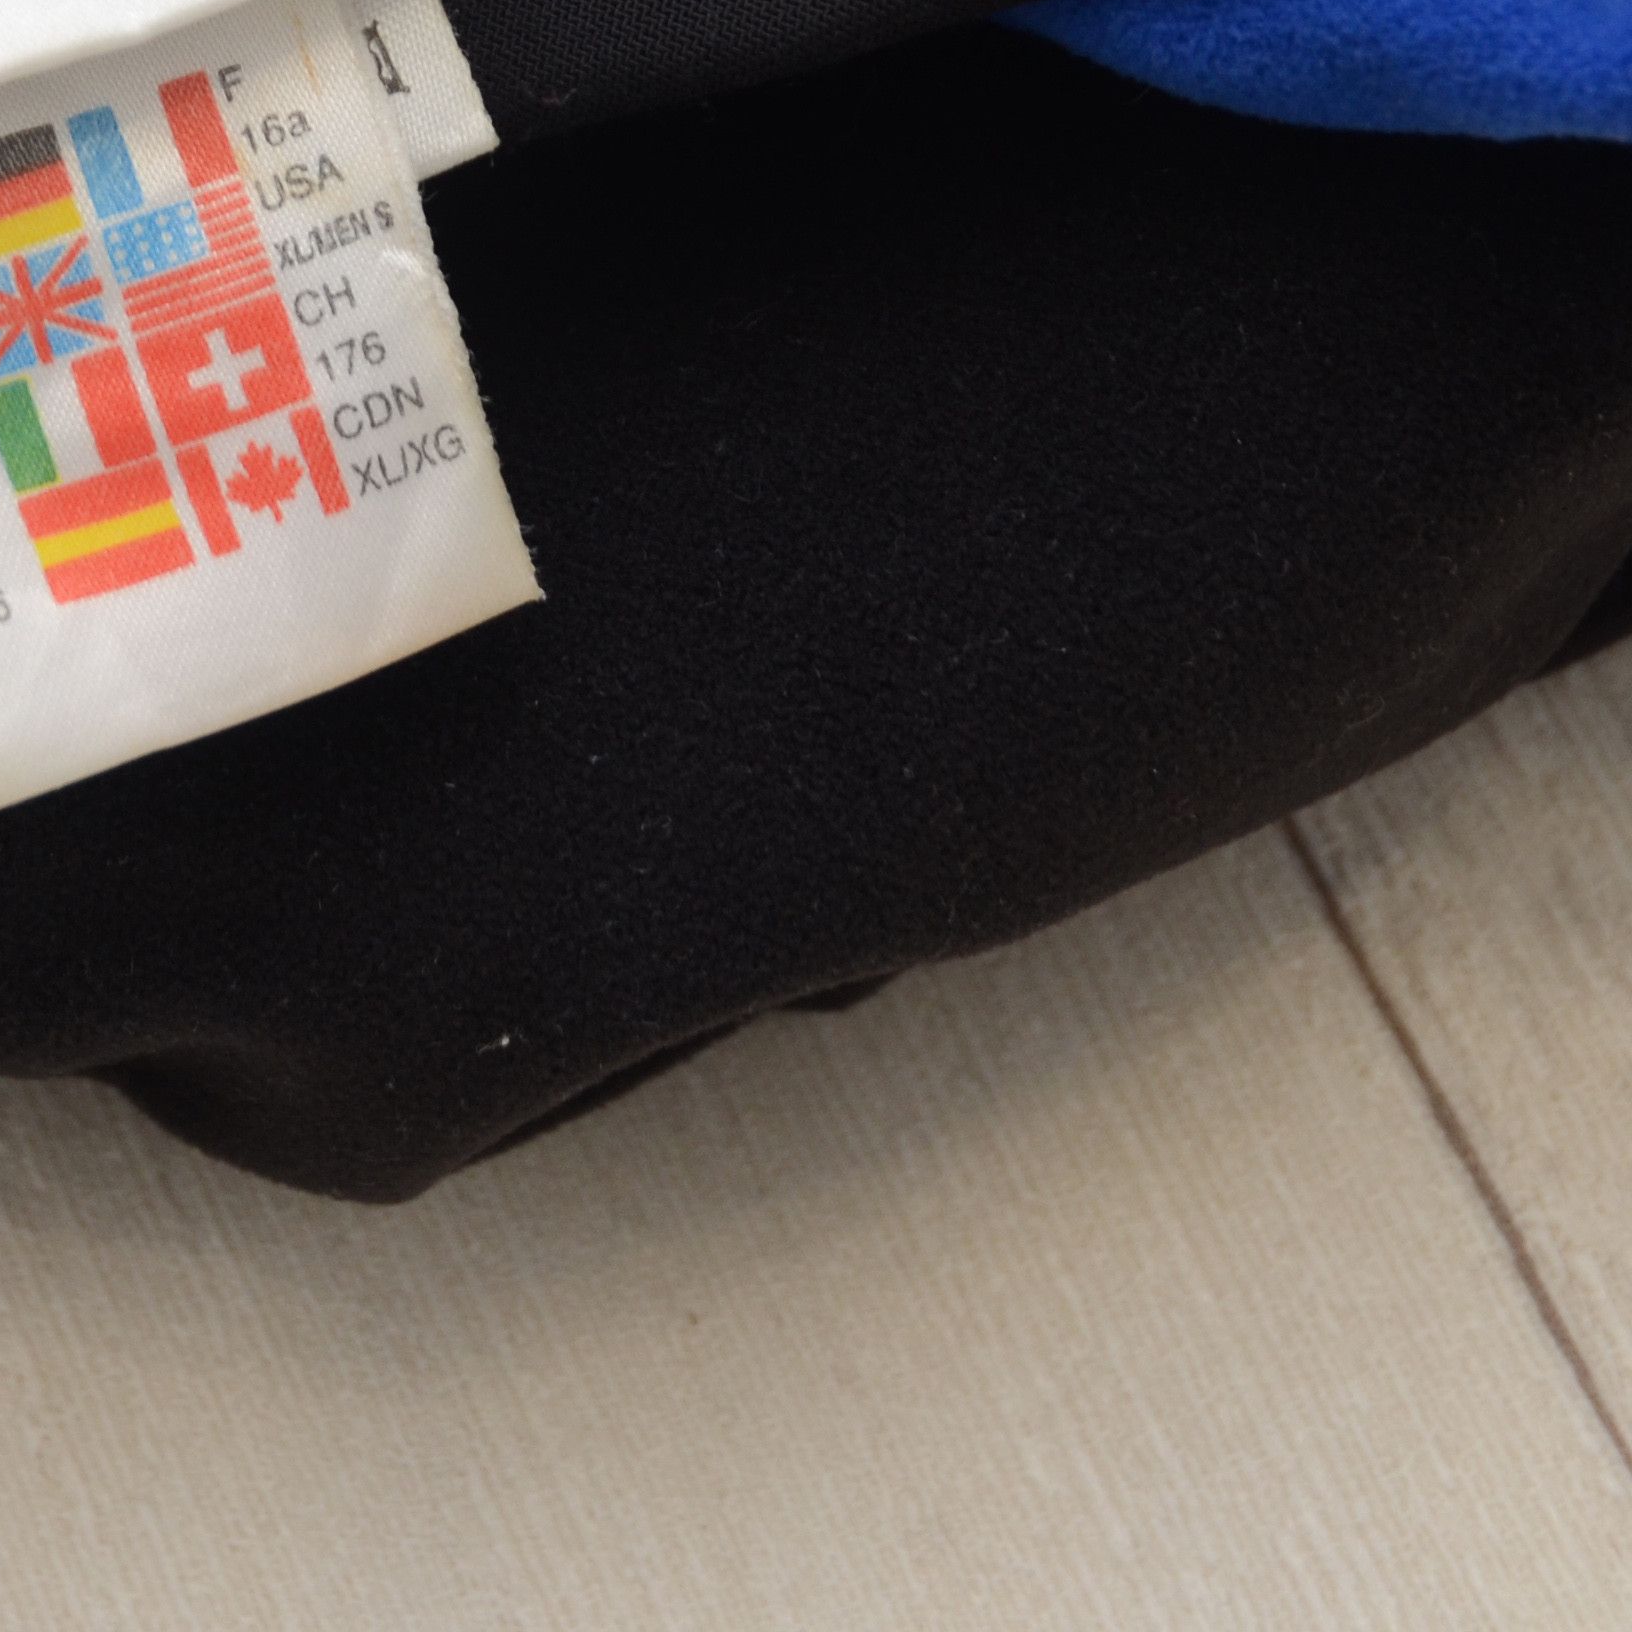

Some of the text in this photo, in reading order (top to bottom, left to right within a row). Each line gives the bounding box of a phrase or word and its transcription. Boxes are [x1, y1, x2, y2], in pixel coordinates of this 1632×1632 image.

[218, 65, 243, 101] F
[242, 109, 312, 155] 16a
[256, 154, 345, 210] USA
[294, 276, 357, 327] CH
[316, 331, 387, 381] 176
[333, 377, 426, 440] CDN
[352, 424, 467, 497] XL/XG
